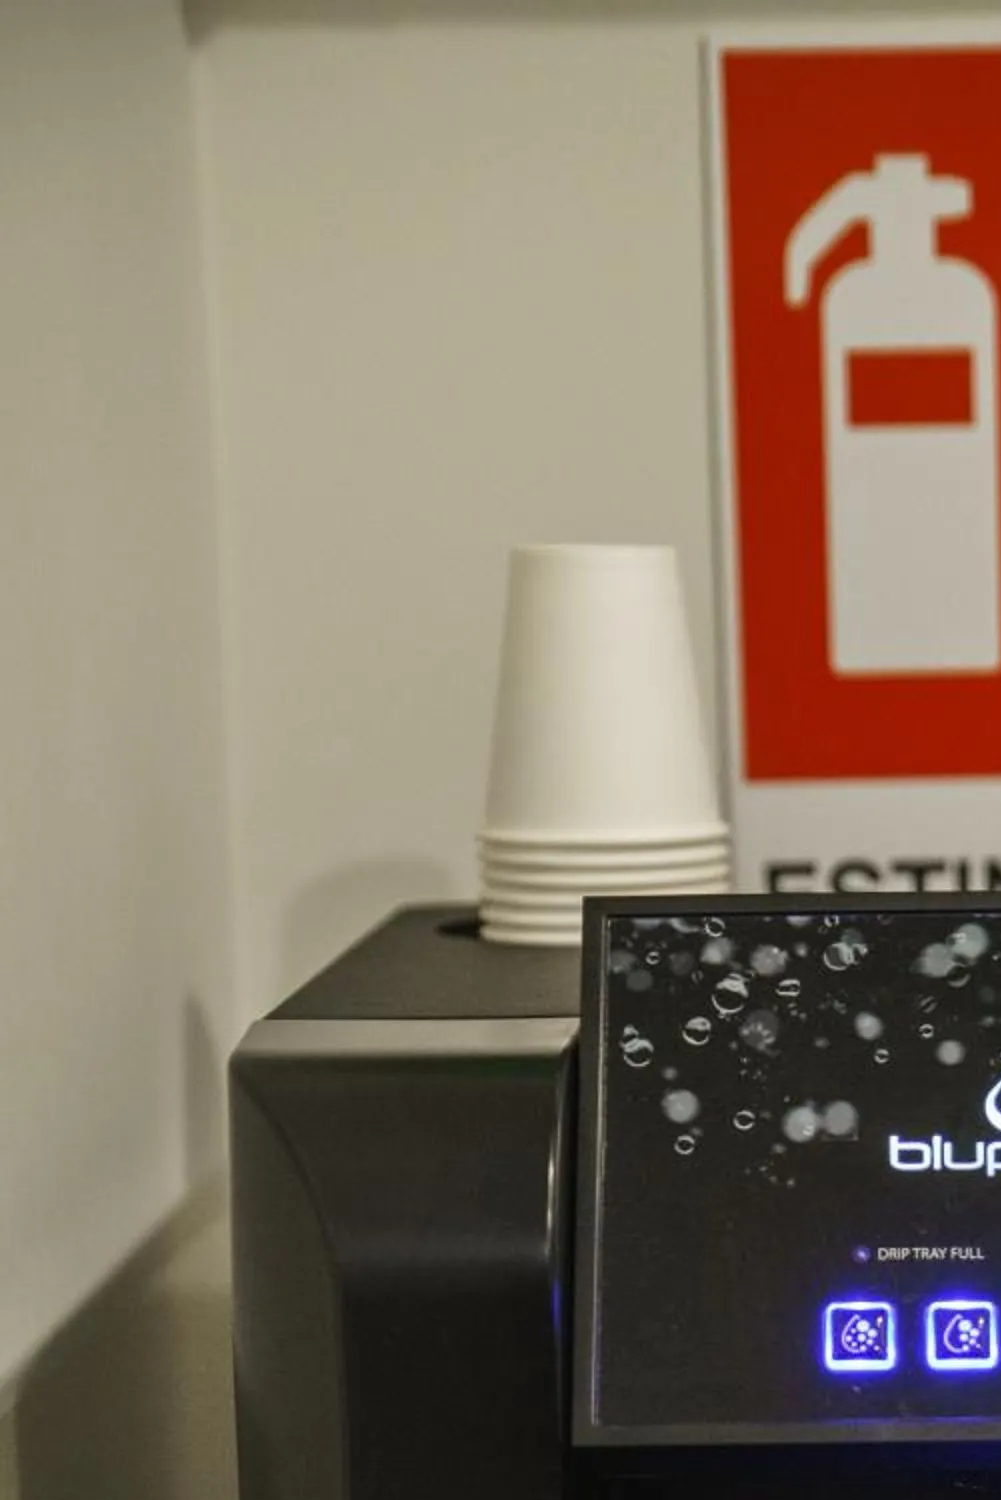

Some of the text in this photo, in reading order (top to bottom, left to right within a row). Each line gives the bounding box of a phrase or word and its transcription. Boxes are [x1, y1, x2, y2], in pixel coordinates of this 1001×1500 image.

[877, 1247, 985, 1261] DRIP TRAY FULL
